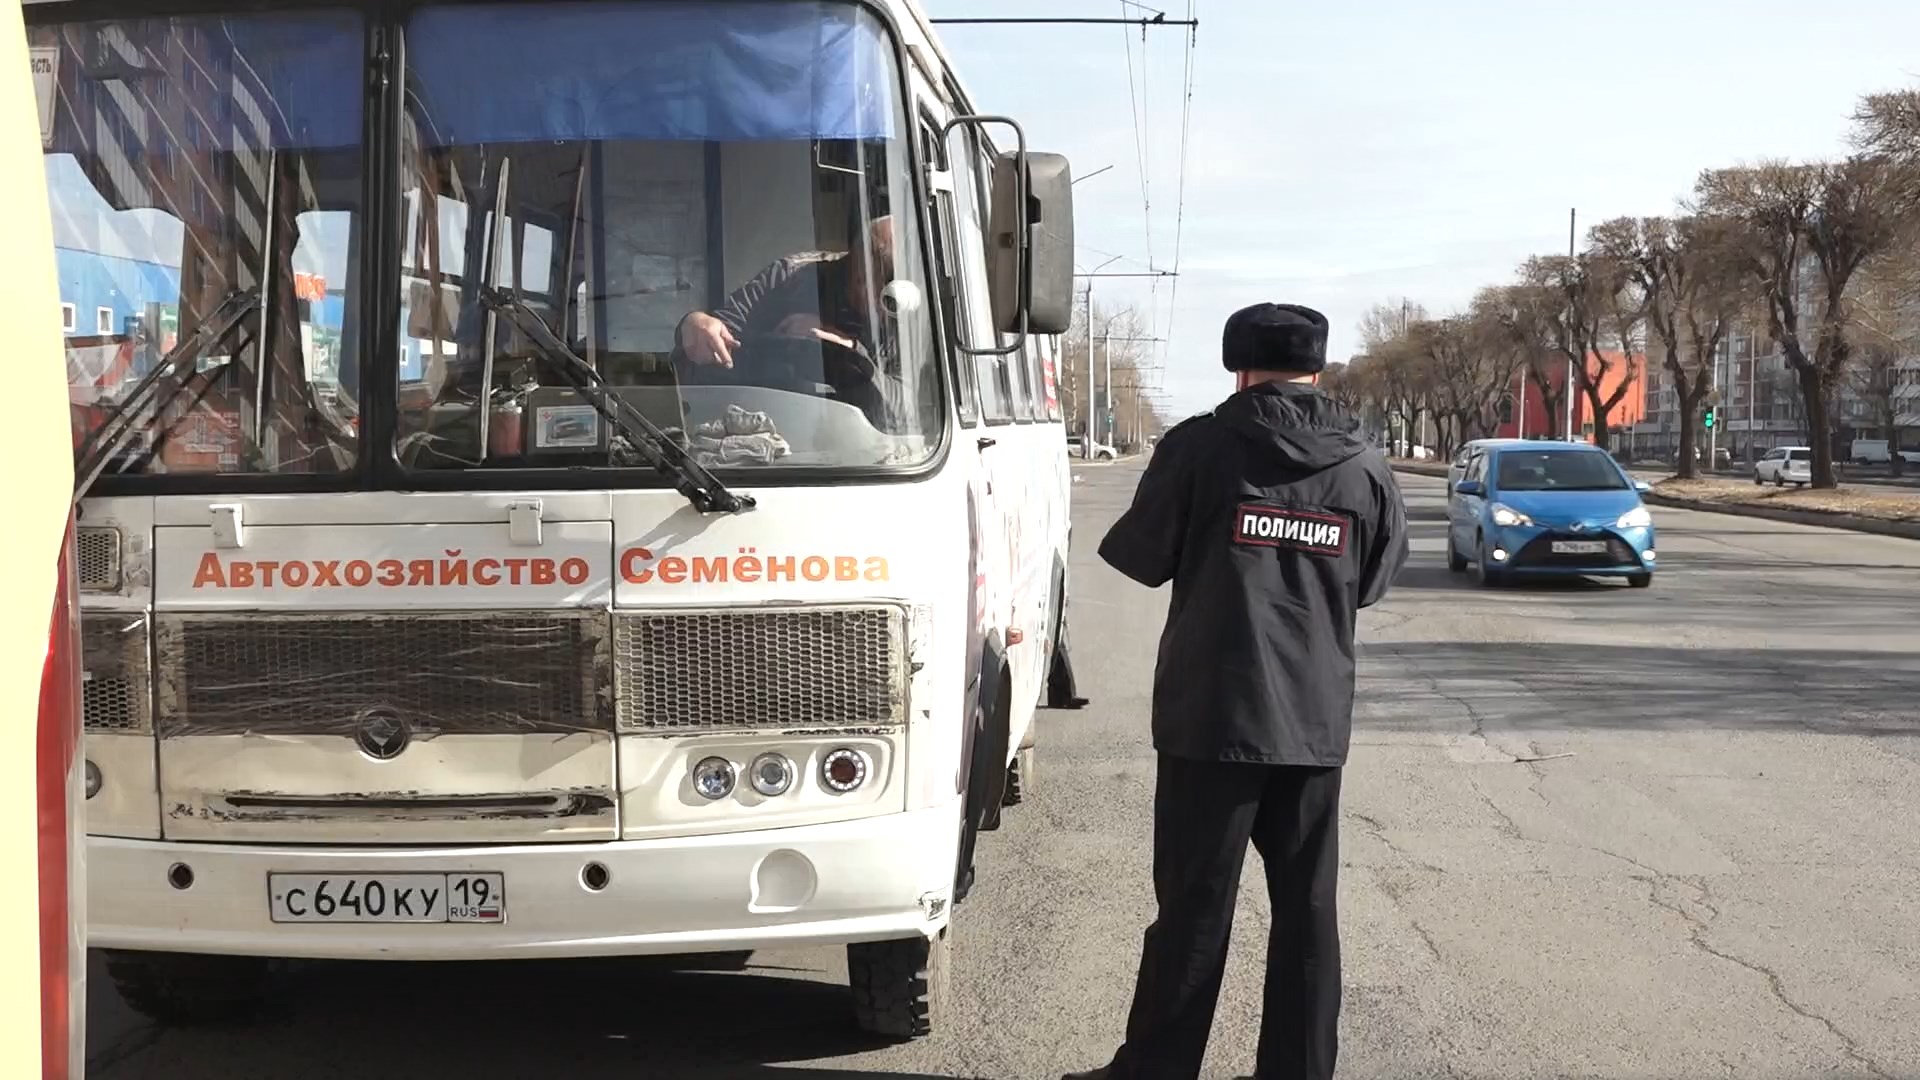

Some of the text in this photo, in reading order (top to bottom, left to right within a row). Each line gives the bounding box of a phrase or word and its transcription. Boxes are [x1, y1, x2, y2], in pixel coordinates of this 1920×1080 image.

[1242, 514, 1341, 546] ПОЛИЦИЯ
[192, 547, 890, 588] Автохозяйство Семёнова
[454, 878, 489, 906] 19
[450, 906, 478, 918] RUS
